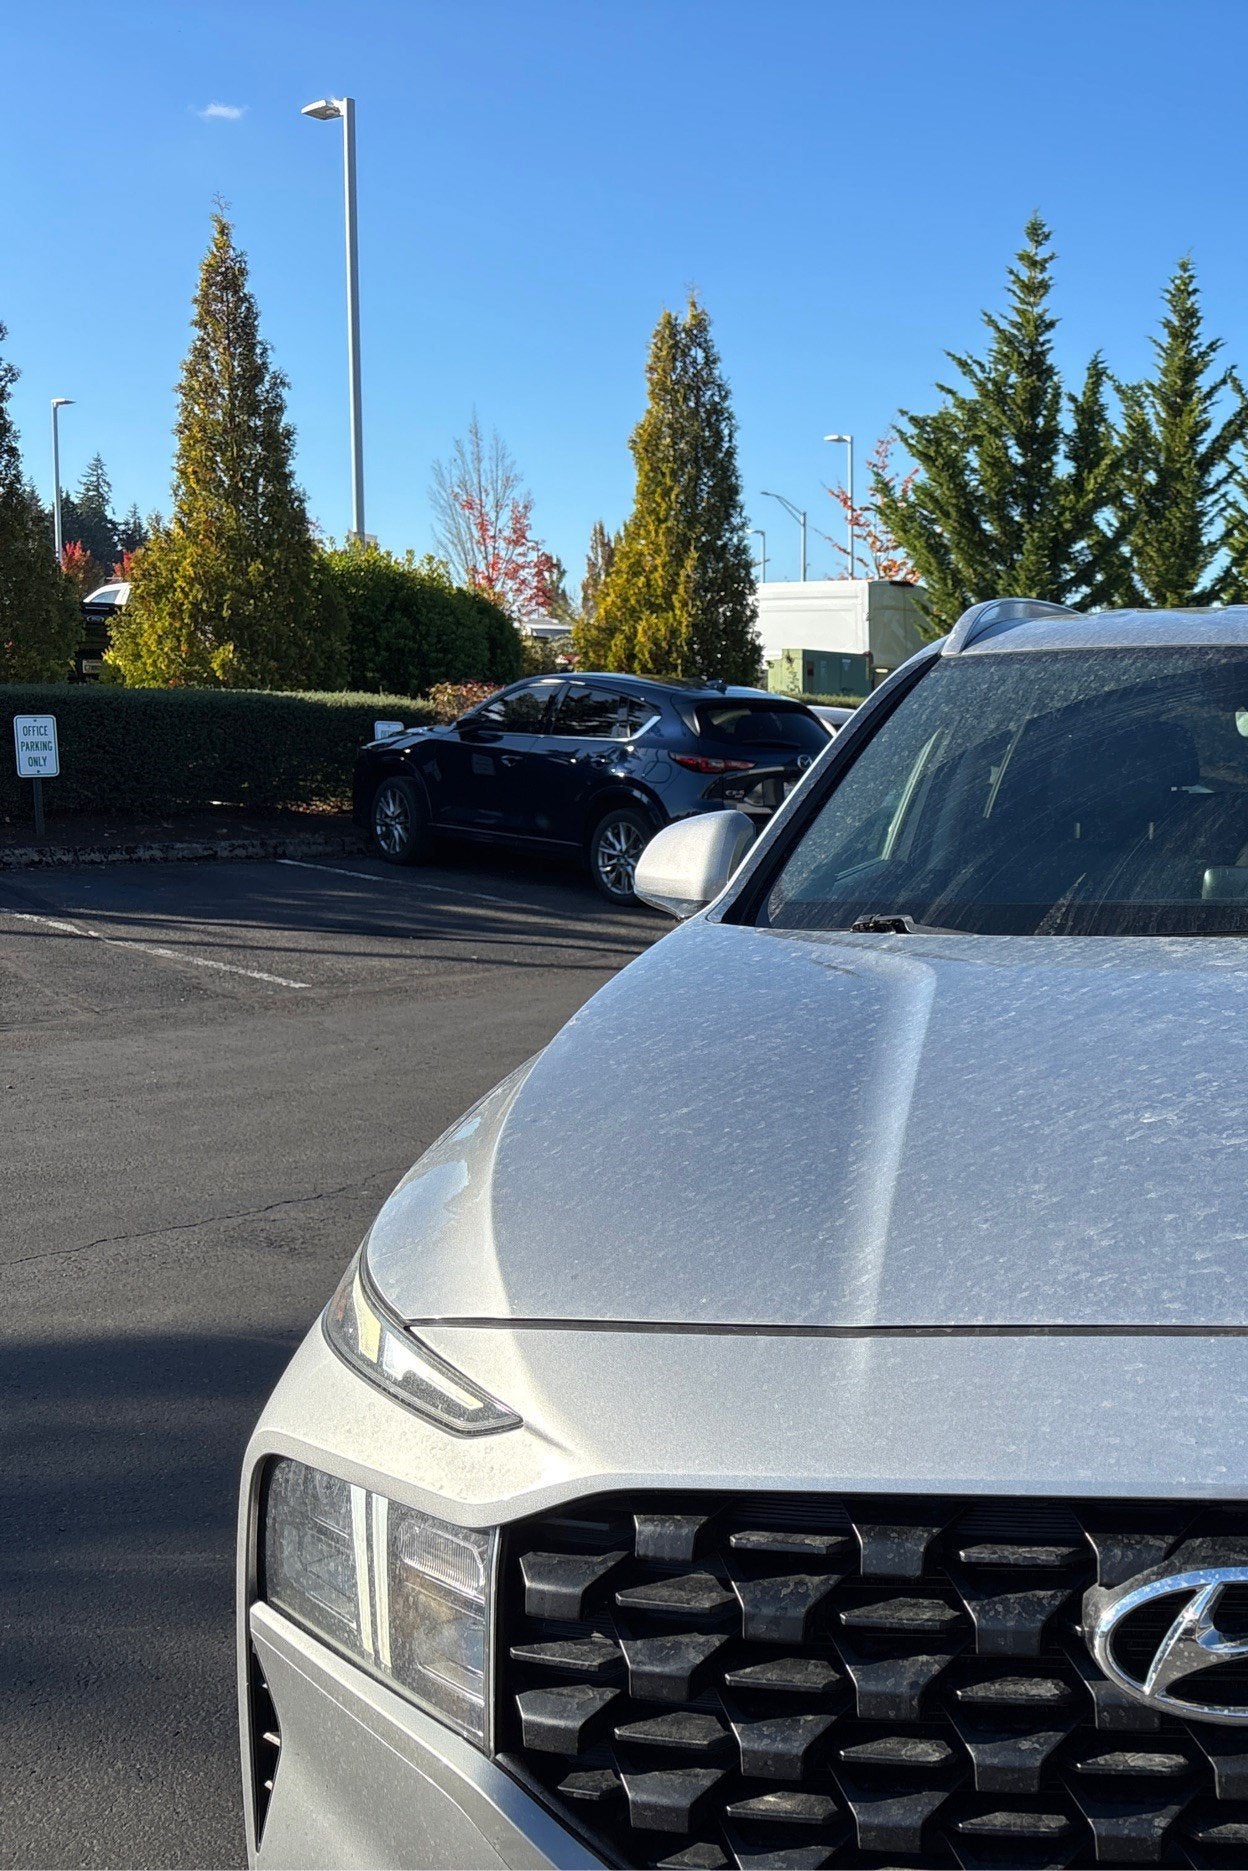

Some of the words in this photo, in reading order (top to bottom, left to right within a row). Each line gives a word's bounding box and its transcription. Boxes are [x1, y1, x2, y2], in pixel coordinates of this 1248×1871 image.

[22, 725, 48, 736] OFFICE
[20, 740, 53, 752] PARKING
[27, 756, 47, 767] ONLY
